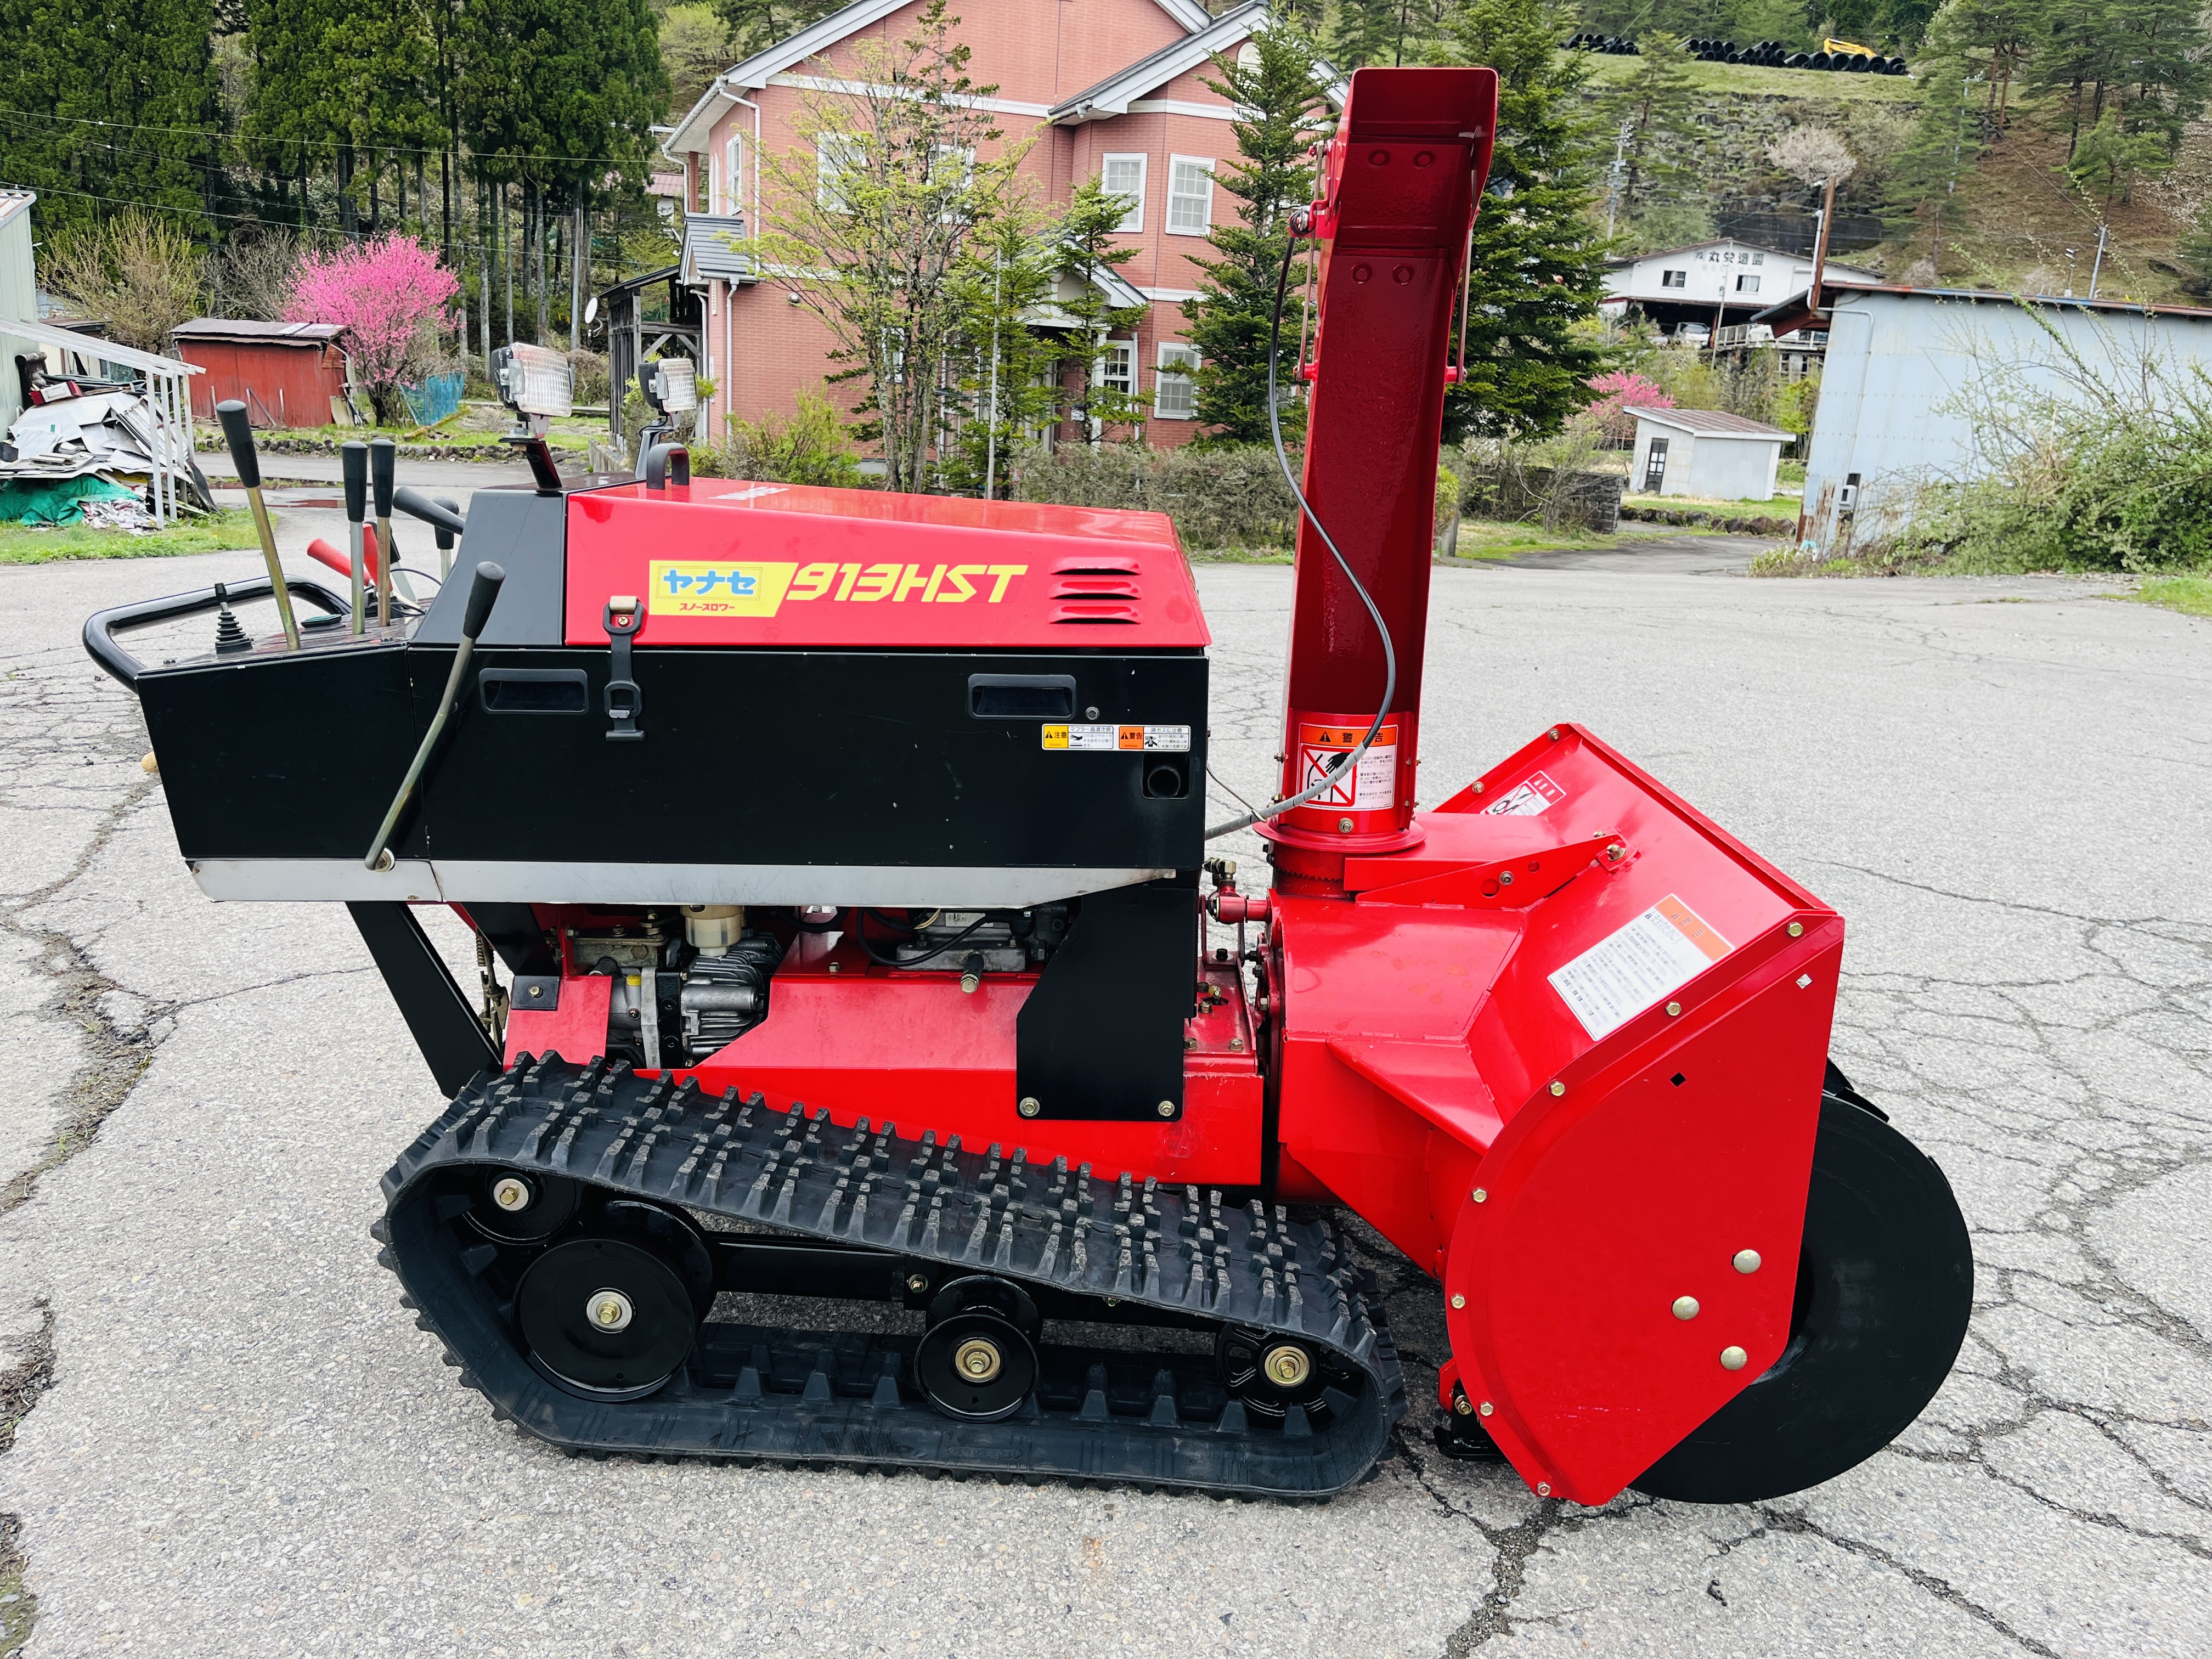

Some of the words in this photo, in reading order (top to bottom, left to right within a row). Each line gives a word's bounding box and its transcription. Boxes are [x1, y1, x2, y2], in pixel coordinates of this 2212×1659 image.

[663, 569, 757, 595] ヤナセ
[786, 562, 1029, 603] 913HST
[679, 603, 735, 612] スノースロワー
